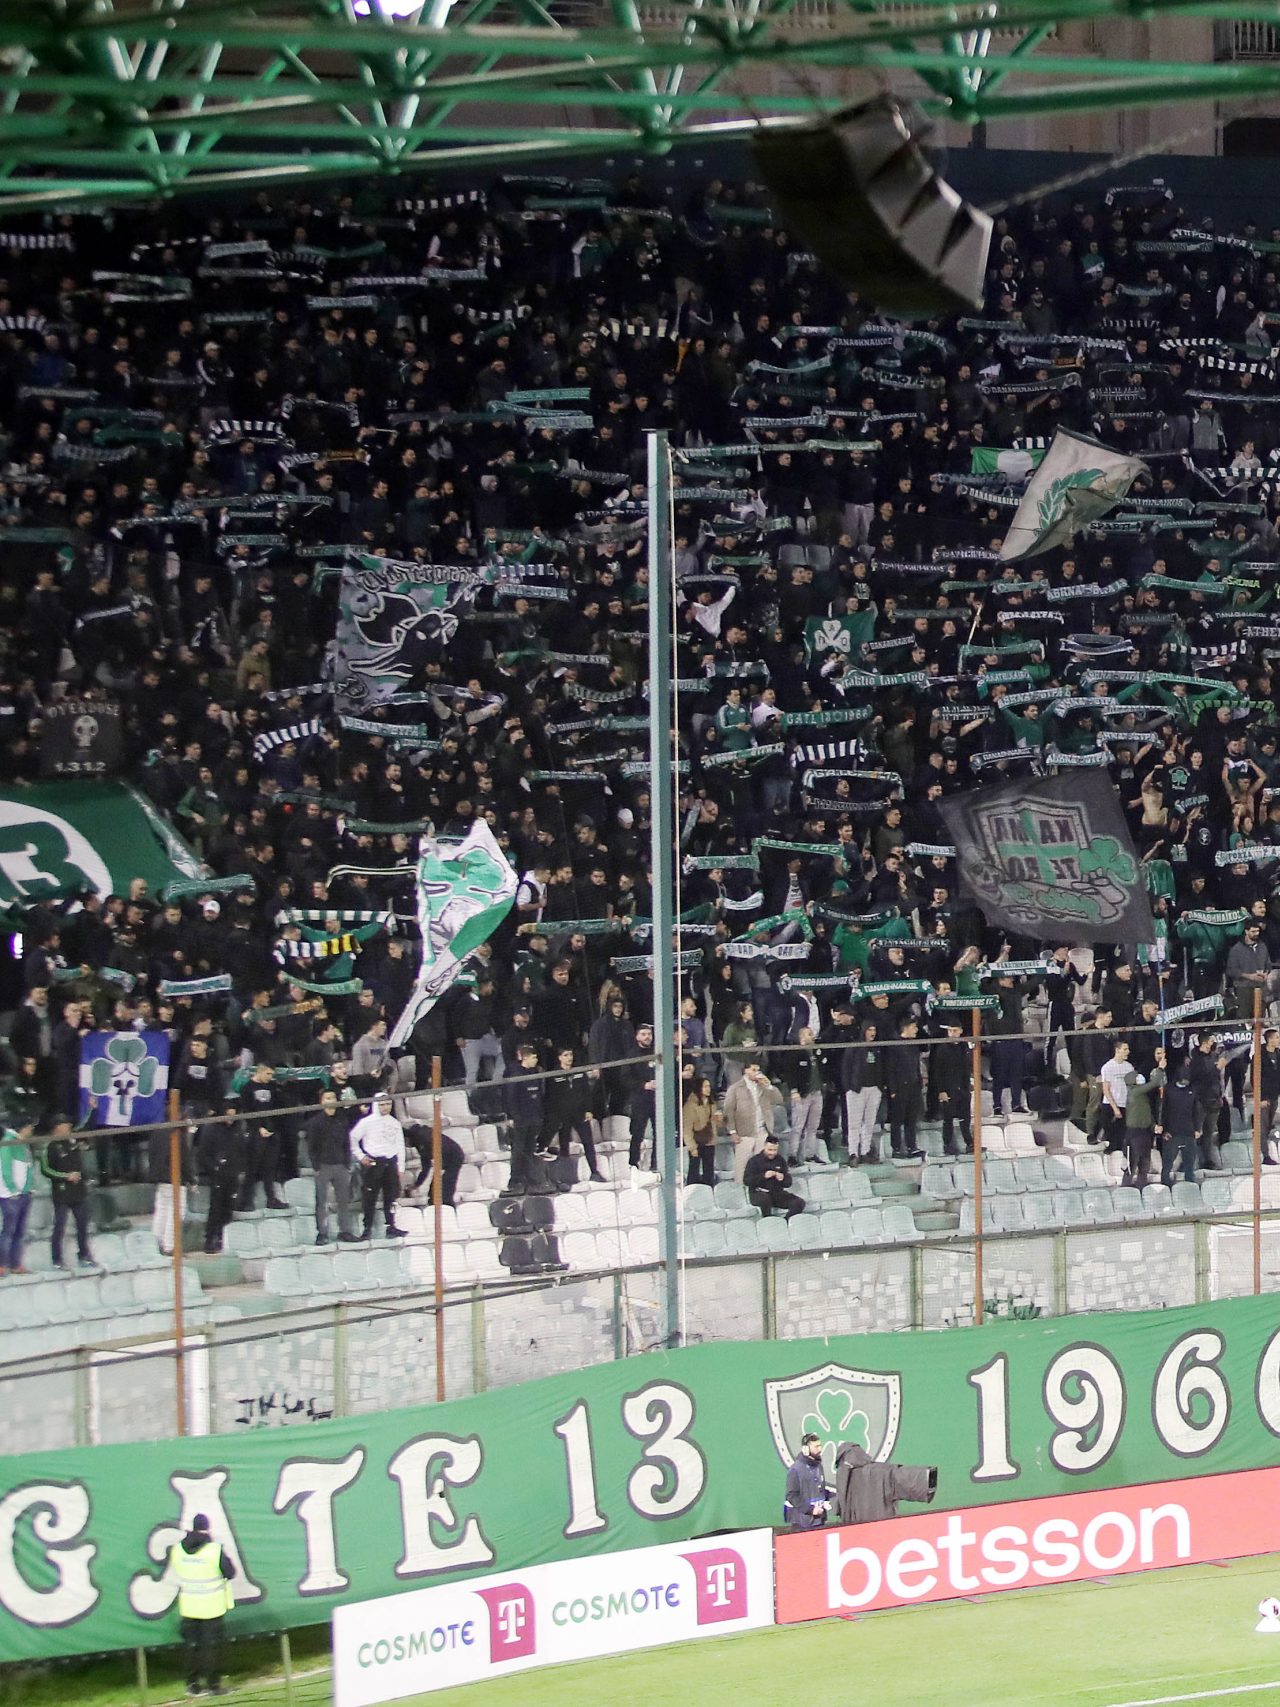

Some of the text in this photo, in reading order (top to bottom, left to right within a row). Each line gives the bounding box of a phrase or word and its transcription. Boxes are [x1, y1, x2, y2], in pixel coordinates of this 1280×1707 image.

[2, 1377, 706, 1628] GATE 13
[825, 1501, 1192, 1609] betsson
[357, 1619, 475, 1669] COSMOTE
[552, 1582, 681, 1627] COSMOTE
